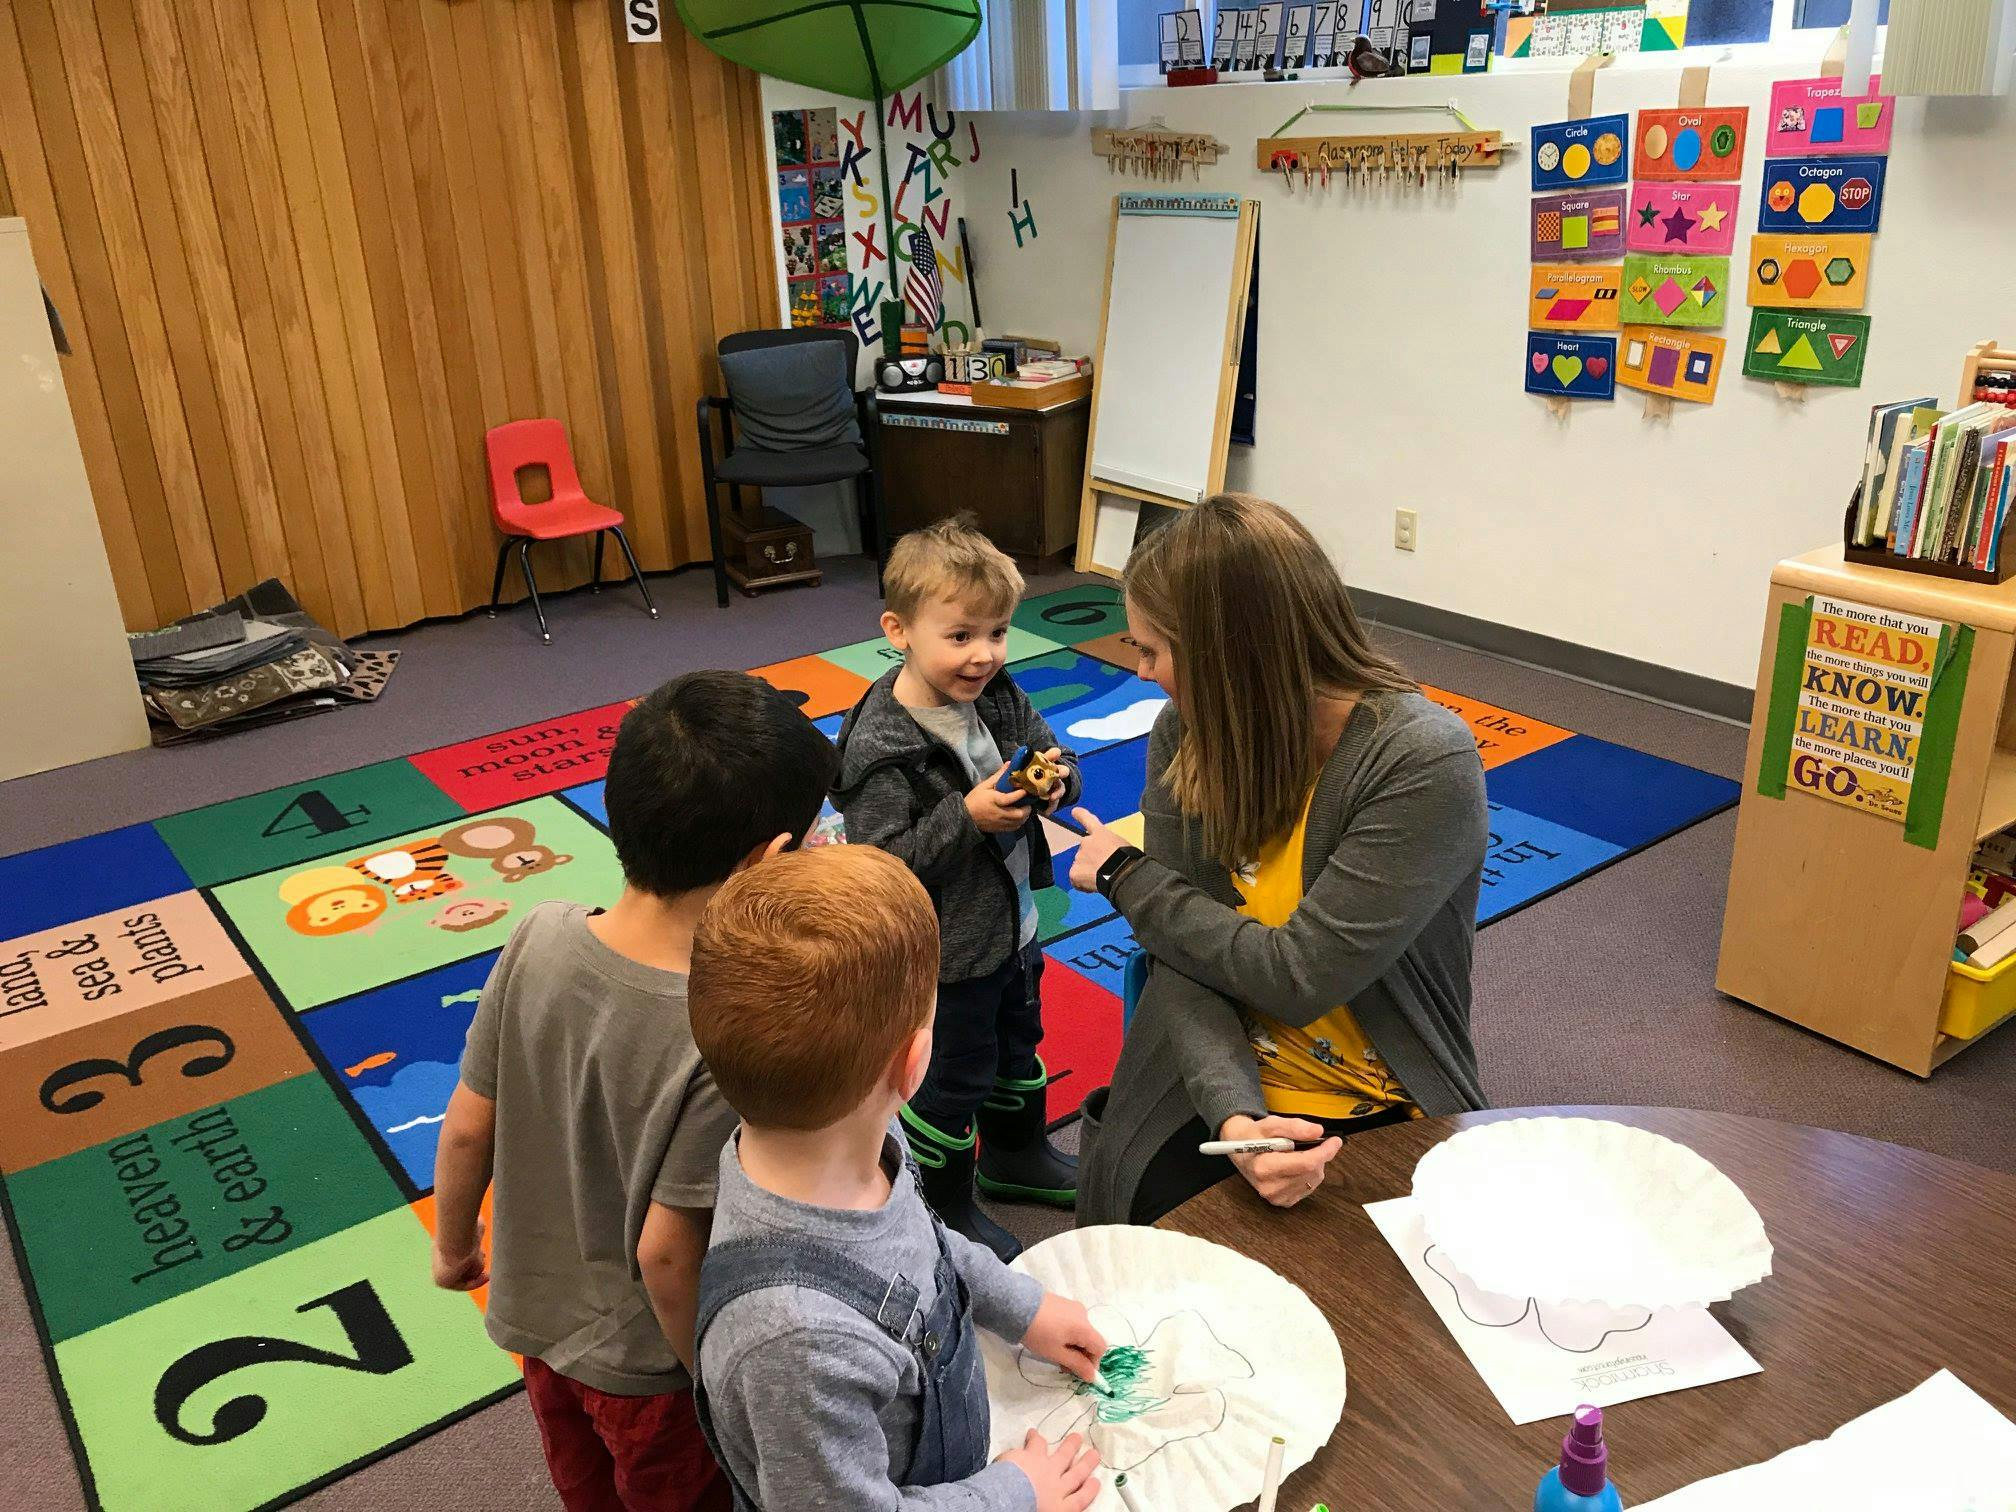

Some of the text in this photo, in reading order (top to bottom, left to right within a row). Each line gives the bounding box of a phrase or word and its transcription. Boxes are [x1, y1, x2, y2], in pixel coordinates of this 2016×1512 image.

[629, 0, 658, 36] S
[1178, 16, 1189, 41] 2
[1215, 13, 1225, 39] 3
[1241, 13, 1253, 39] 4
[1259, 8, 1270, 35] 5
[1290, 10, 1299, 36] 6
[1314, 6, 1330, 34] 7
[1336, 4, 1348, 31] 8
[1372, 0, 1383, 27] 9
[887, 91, 922, 133] M
[1806, 86, 1841, 99] Trapez
[840, 110, 865, 151] Y
[926, 103, 955, 140] U
[1565, 126, 1588, 138] Circle
[1679, 115, 1702, 126] Oval
[926, 139, 961, 180] R
[969, 121, 980, 163] J
[1437, 137, 1475, 162] Today
[780, 174, 787, 185] 3
[841, 140, 872, 187] K
[906, 142, 927, 185] T
[914, 159, 943, 203] Z
[1799, 166, 1843, 179] Octagon
[852, 177, 878, 218] S
[894, 181, 908, 223] L
[1561, 201, 1589, 213] Square
[1672, 190, 1691, 201] Star
[1841, 187, 1870, 200] STOP
[819, 225, 826, 236] 6
[923, 199, 950, 240] V
[1008, 200, 1037, 248] H
[852, 223, 887, 269] X
[936, 245, 964, 286] N
[1784, 242, 1828, 255] Hexagon
[1547, 273, 1603, 284] Parallelogram
[1653, 264, 1692, 275] Rhombus
[848, 272, 884, 316] W
[852, 305, 882, 347] E
[1649, 332, 1691, 349] Rectangle
[1787, 318, 1827, 332] Triangle
[1557, 341, 1579, 351] Heart
[950, 357, 958, 380] 1
[1822, 602, 1929, 636] The more that you
[1813, 618, 1930, 674] READ,
[1806, 649, 1929, 689] the more things you will
[1802, 664, 1923, 719] KNOW.
[1474, 714, 1527, 737] the
[1808, 695, 1912, 733] The more that you
[457, 738, 586, 778] moon
[486, 727, 579, 754] sun,
[1795, 736, 1910, 779] the more places you'll
[1799, 709, 1914, 766] LEARN,
[1793, 754, 1864, 803] GO.
[261, 789, 371, 840] 4
[1490, 840, 1562, 864] In
[45, 932, 122, 1001] sea &
[117, 912, 204, 984] plants
[39, 1023, 237, 1115] 3
[171, 1106, 293, 1254] & earth
[108, 1132, 204, 1285] heaven
[153, 1278, 415, 1447] 2
[1573, 1360, 1676, 1392] Shamrock
